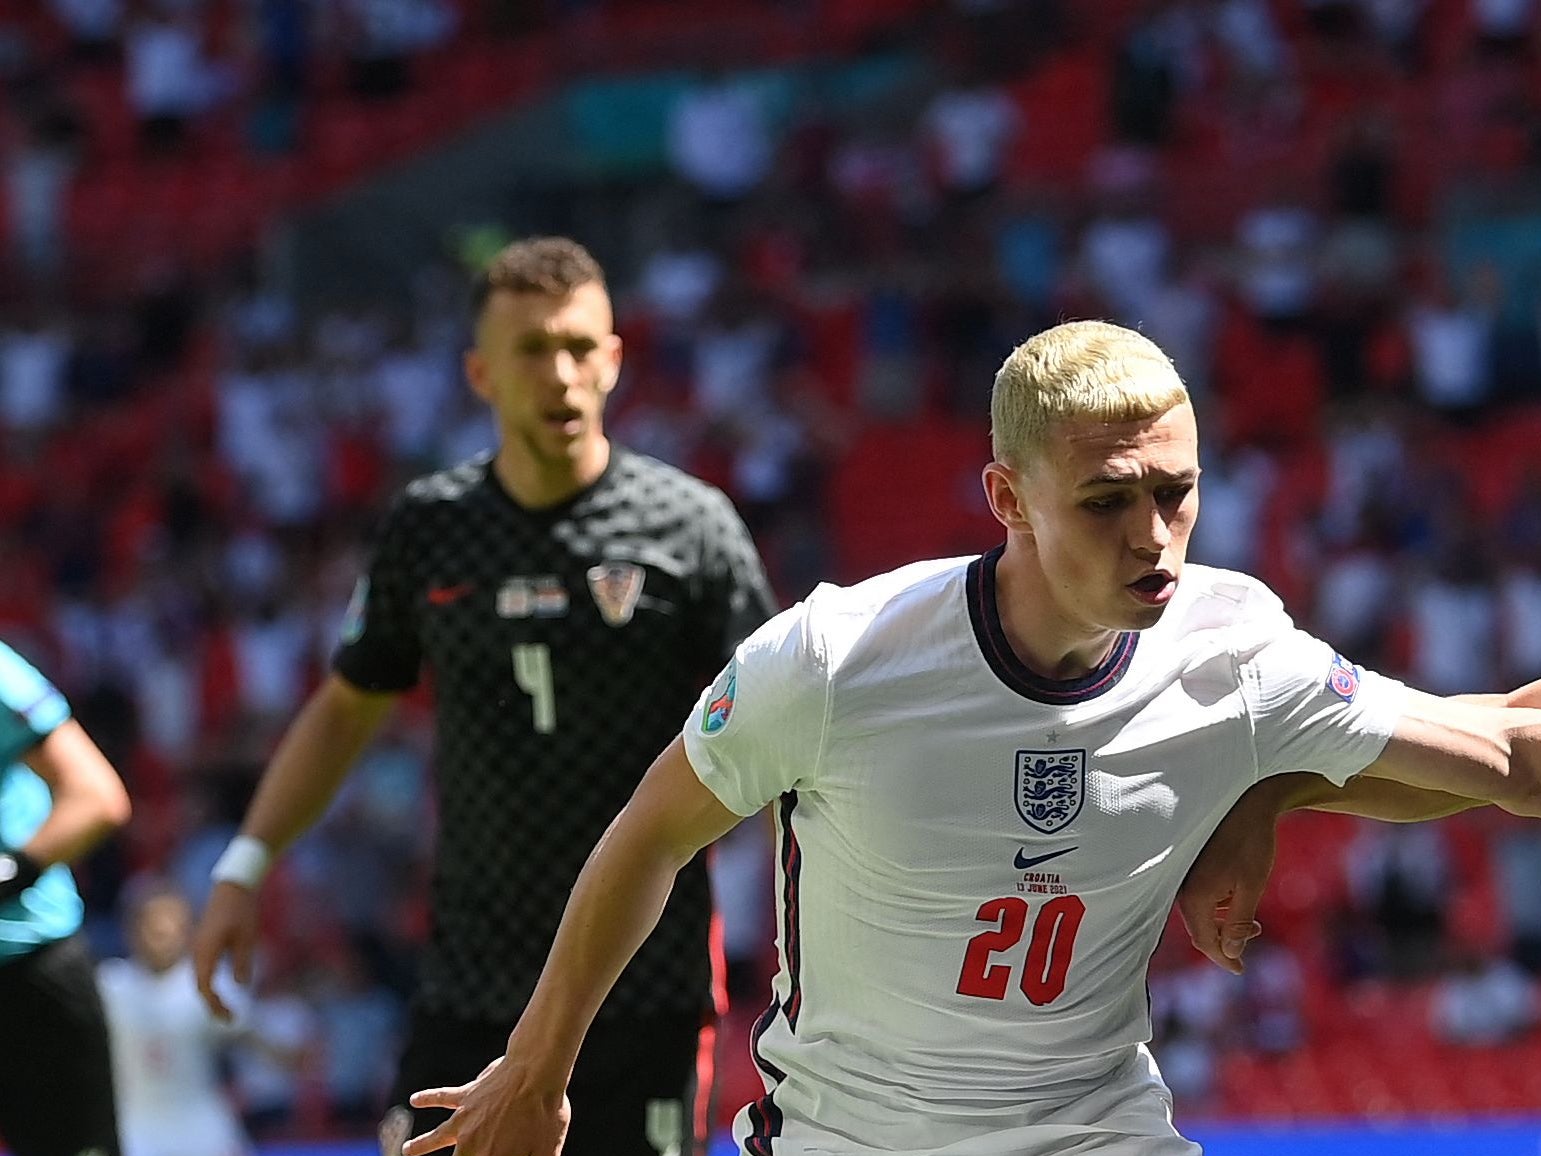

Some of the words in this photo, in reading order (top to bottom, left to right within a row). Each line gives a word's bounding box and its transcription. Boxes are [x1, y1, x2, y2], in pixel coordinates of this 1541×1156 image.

[511, 642, 559, 736] 4
[1016, 881, 1025, 892] 13
[1027, 883, 1048, 894] JUNE
[1050, 884, 1068, 895] 2021
[1023, 872, 1060, 884] CROATIA
[955, 894, 1087, 1007] 20
